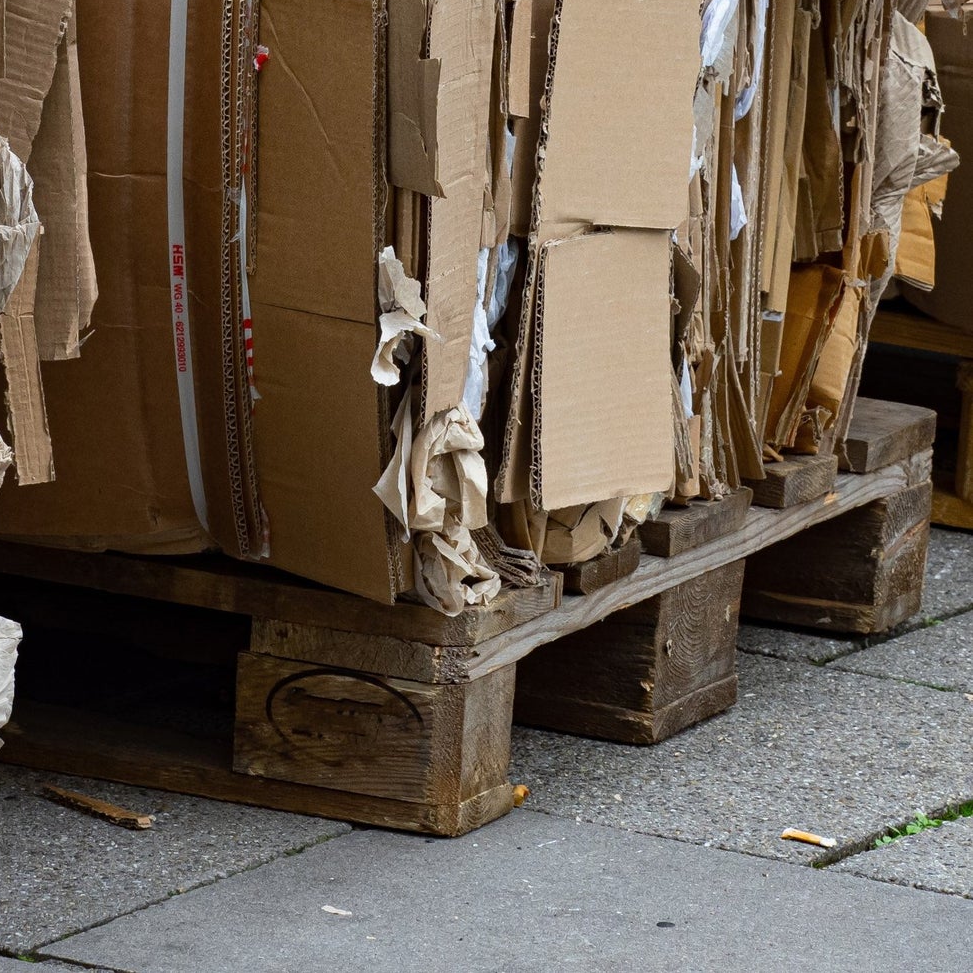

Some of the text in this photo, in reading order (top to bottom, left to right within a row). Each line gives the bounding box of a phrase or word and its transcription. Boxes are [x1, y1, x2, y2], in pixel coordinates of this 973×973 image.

[172, 244, 184, 277] HSM
[174, 283, 183, 300] WG
[174, 302, 184, 314] 40
